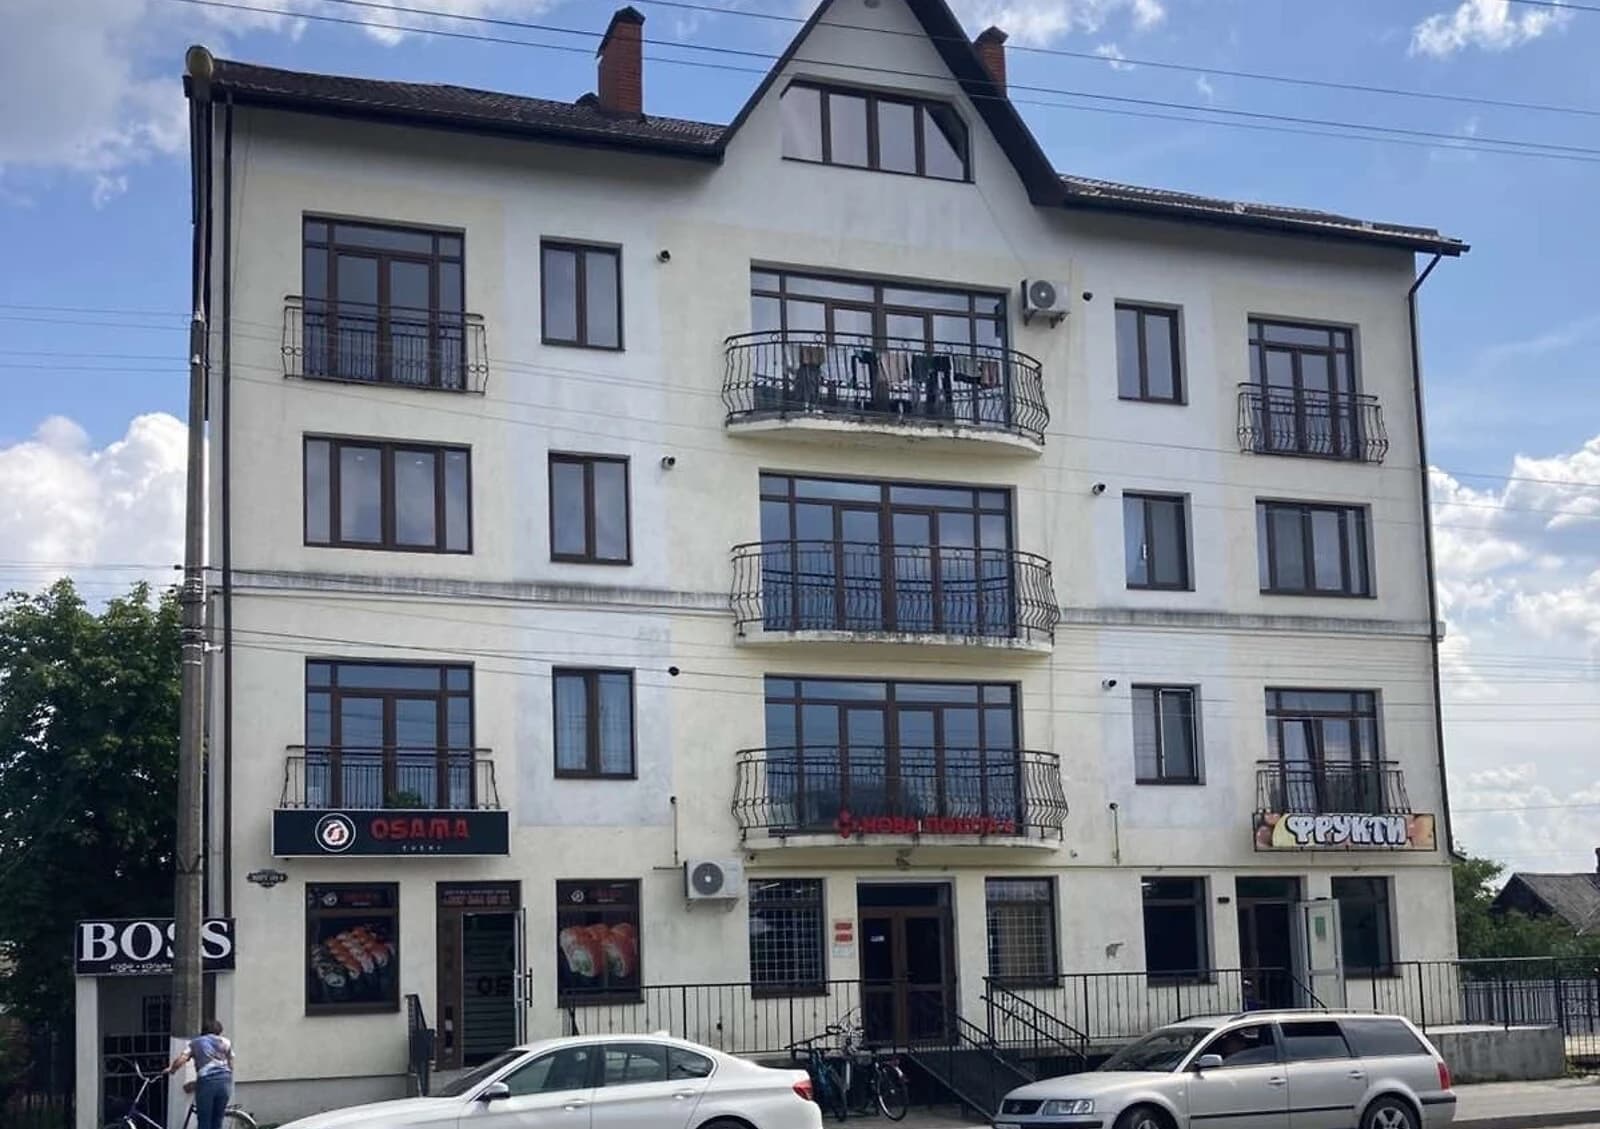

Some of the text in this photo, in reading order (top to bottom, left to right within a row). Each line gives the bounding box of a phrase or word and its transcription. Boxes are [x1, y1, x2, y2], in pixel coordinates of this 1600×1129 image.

[370, 818, 470, 840] OSAMA
[1286, 815, 1407, 844] ФРУКТИ
[79, 920, 232, 961] BOS
